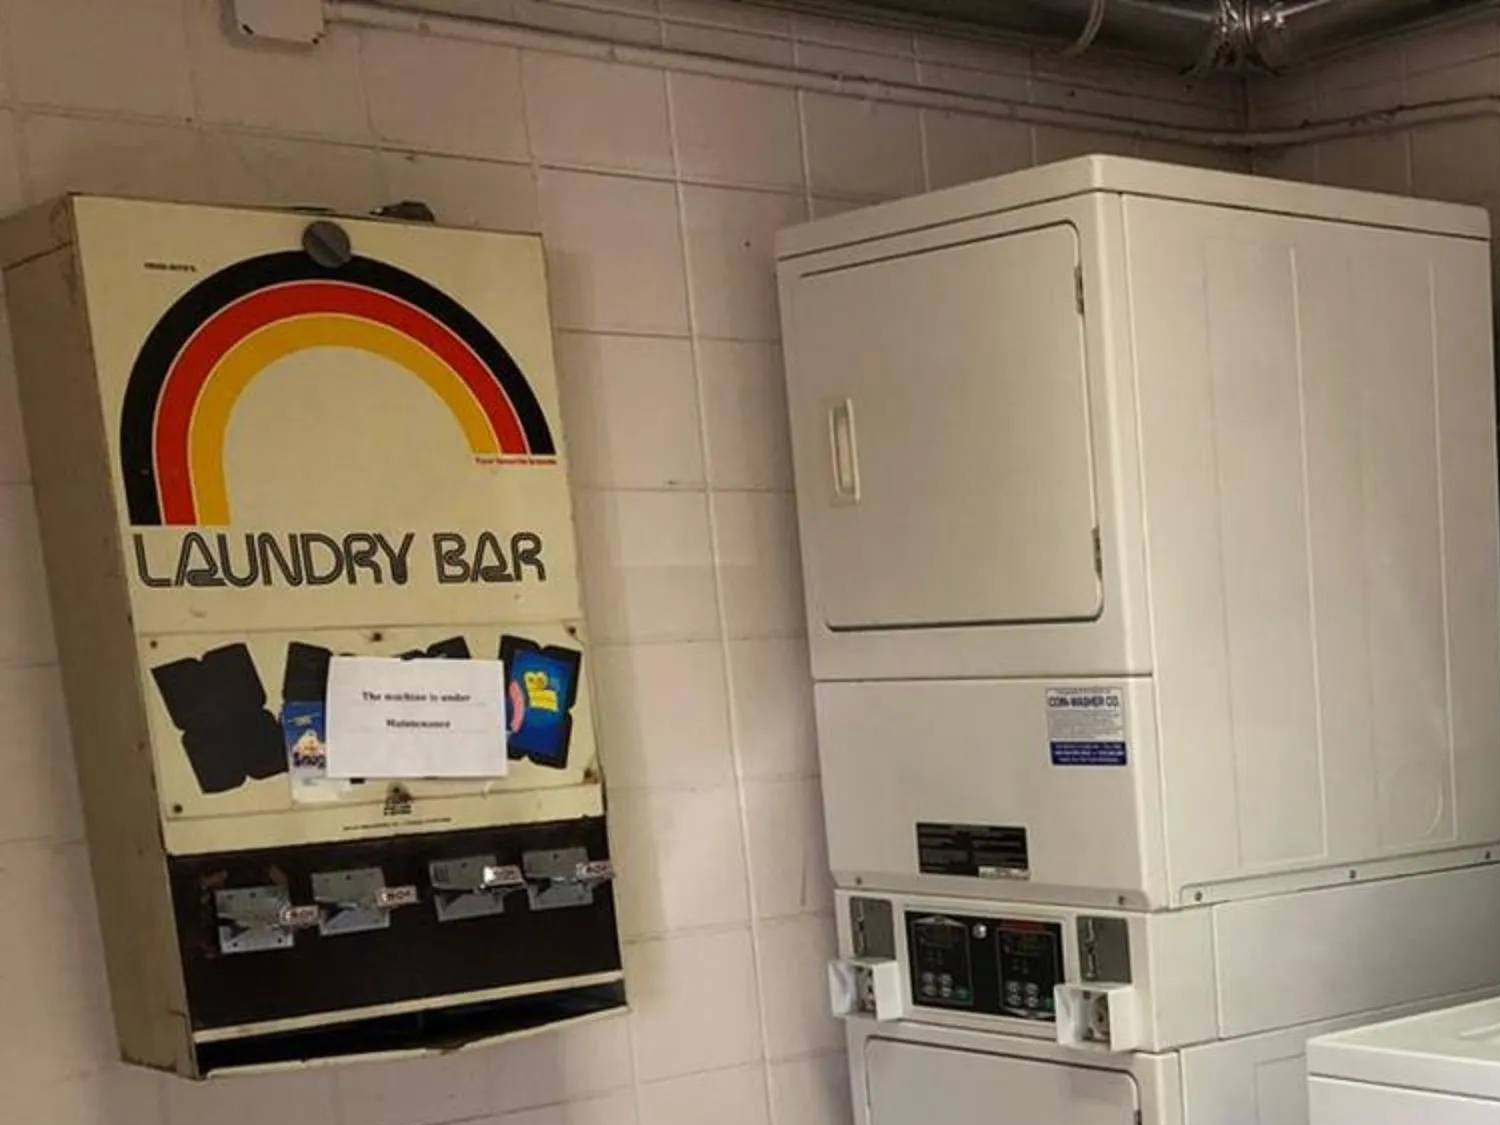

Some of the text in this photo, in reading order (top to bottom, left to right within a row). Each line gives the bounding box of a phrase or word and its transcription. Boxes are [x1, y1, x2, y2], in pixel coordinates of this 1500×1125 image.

[133, 531, 547, 587] LAUNDRY BAR
[362, 691, 381, 701] The
[384, 691, 427, 701] machine
[441, 692, 471, 701] under
[386, 719, 450, 729] Maintenance
